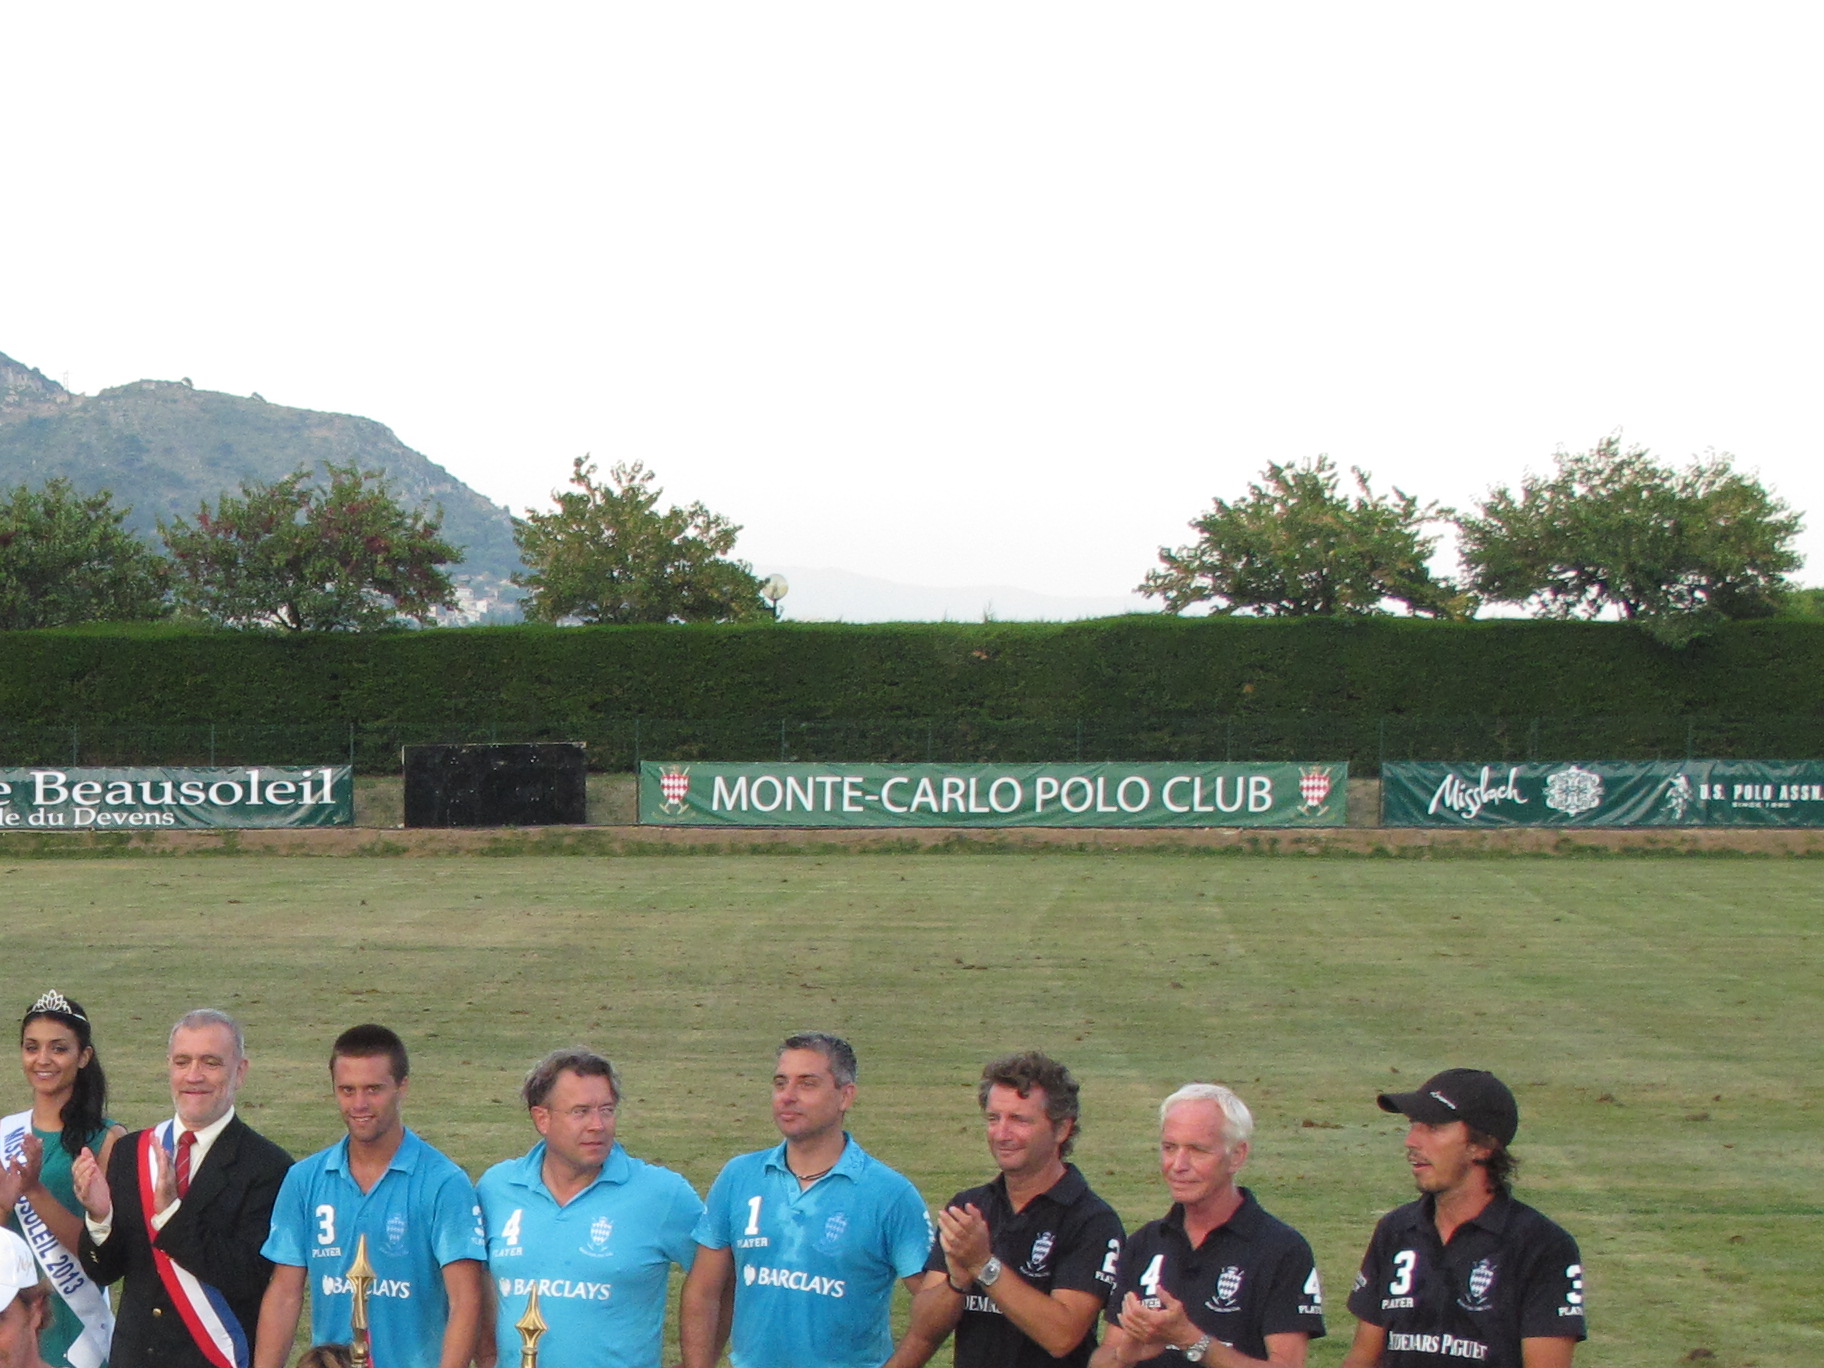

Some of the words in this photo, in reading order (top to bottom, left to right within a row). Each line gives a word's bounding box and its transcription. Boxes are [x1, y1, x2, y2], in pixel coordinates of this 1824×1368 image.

[29, 768, 336, 807] Beausoleil
[712, 775, 1023, 813] MONTE-CARLO
[1035, 776, 1151, 813] POLO
[1162, 776, 1274, 813] CLUB
[1699, 784, 1725, 800] U.S.
[1733, 784, 1774, 801] POLO
[28, 807, 65, 826] du
[74, 807, 175, 827] Devens
[315, 1203, 336, 1246] 3
[501, 1208, 524, 1246] 4
[743, 1195, 764, 1236] 1
[46, 1254, 85, 1296] 2013
[1102, 1238, 1121, 1275] 2
[1139, 1254, 1164, 1296] 4
[1388, 1249, 1416, 1296] 3
[514, 1278, 612, 1301] BARCLAYS
[757, 1266, 847, 1299] BARCLAYS
[1303, 1267, 1322, 1304] 4
